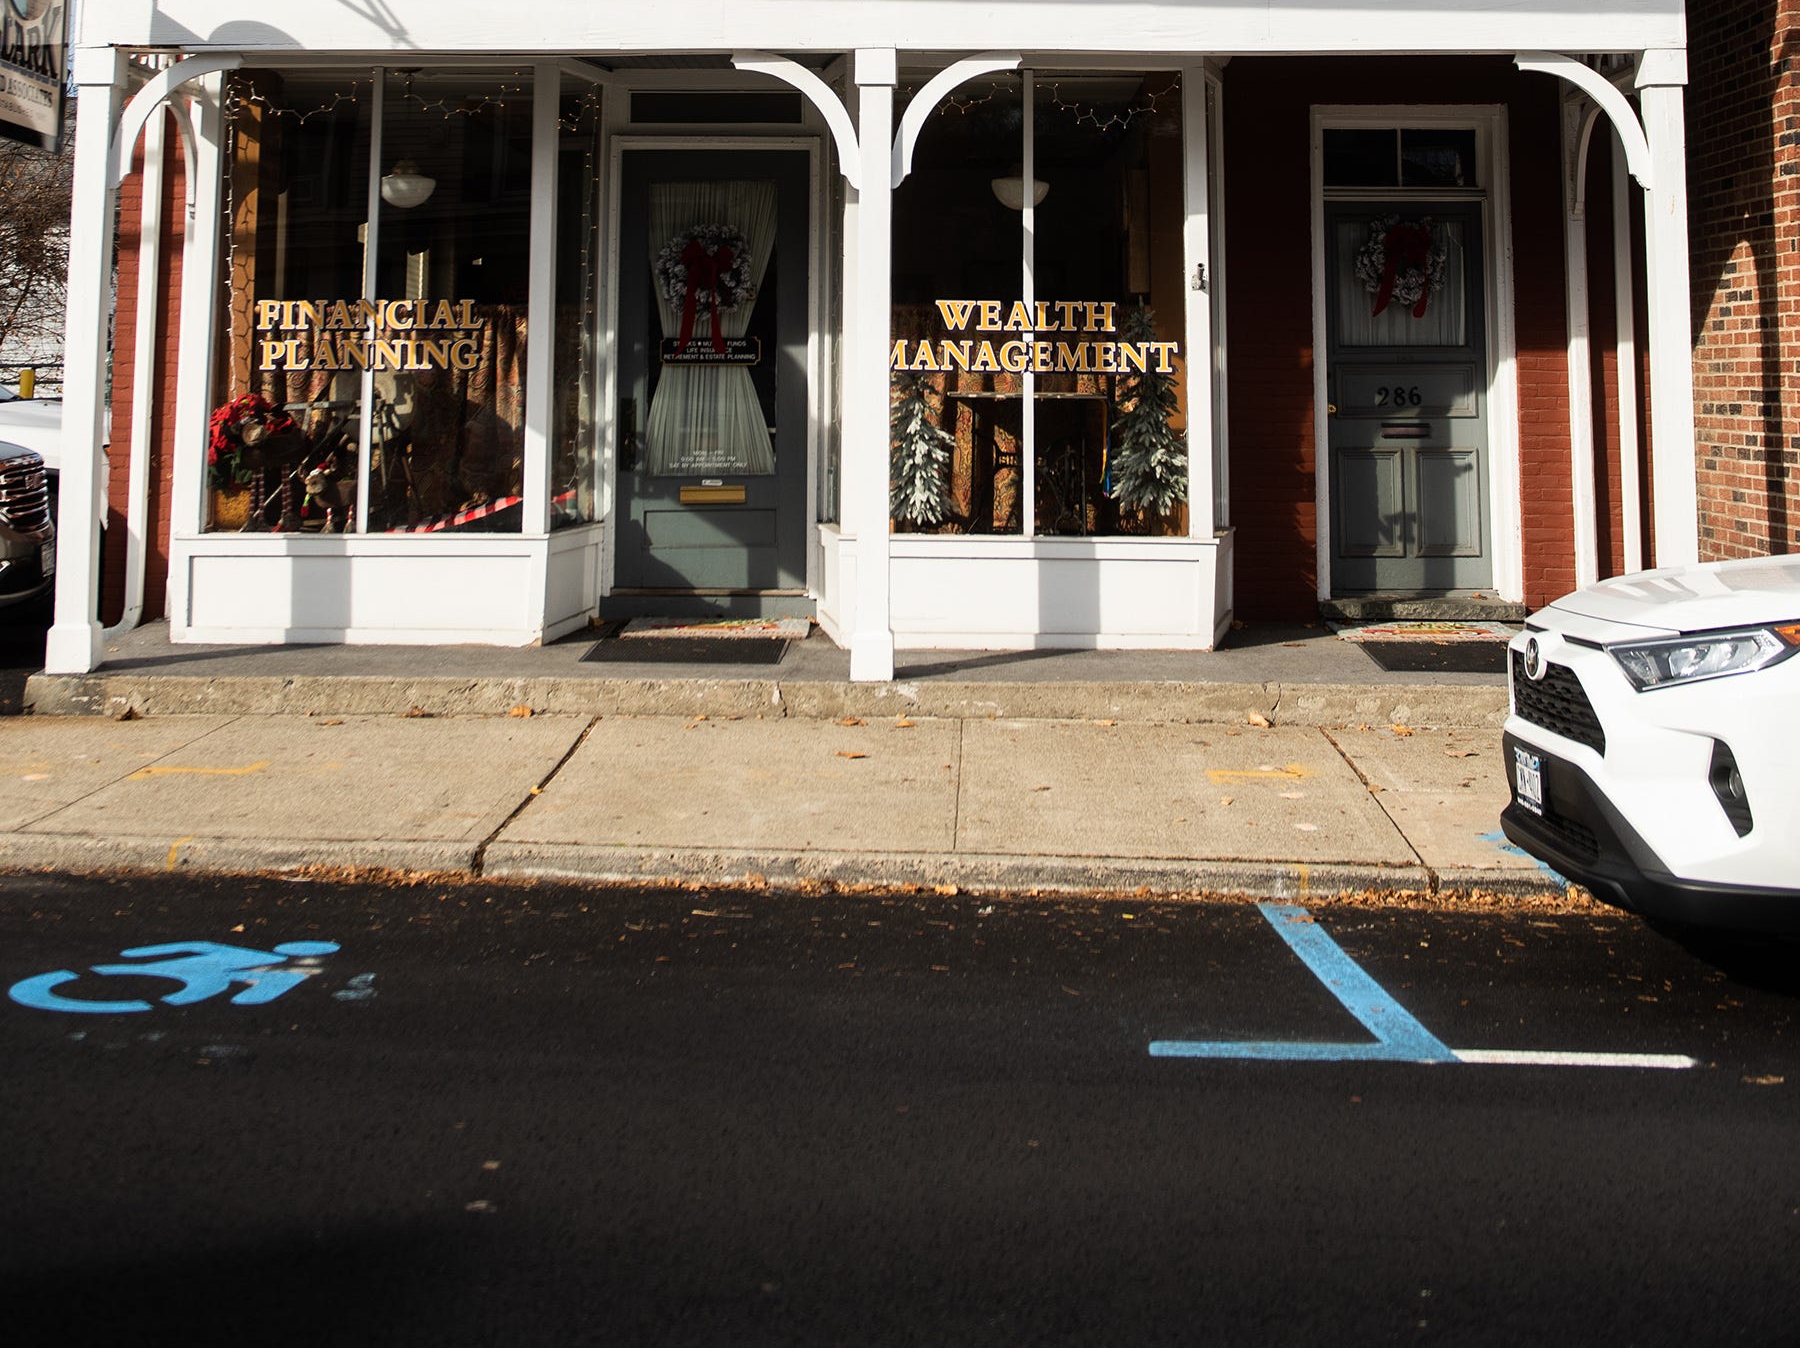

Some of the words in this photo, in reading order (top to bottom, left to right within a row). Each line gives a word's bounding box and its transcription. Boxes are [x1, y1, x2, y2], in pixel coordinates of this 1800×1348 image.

[256, 300, 484, 331] FINANCIAL
[935, 299, 1117, 332] WEALTH
[259, 339, 480, 371] PLANNING
[1377, 386, 1422, 407] 286
